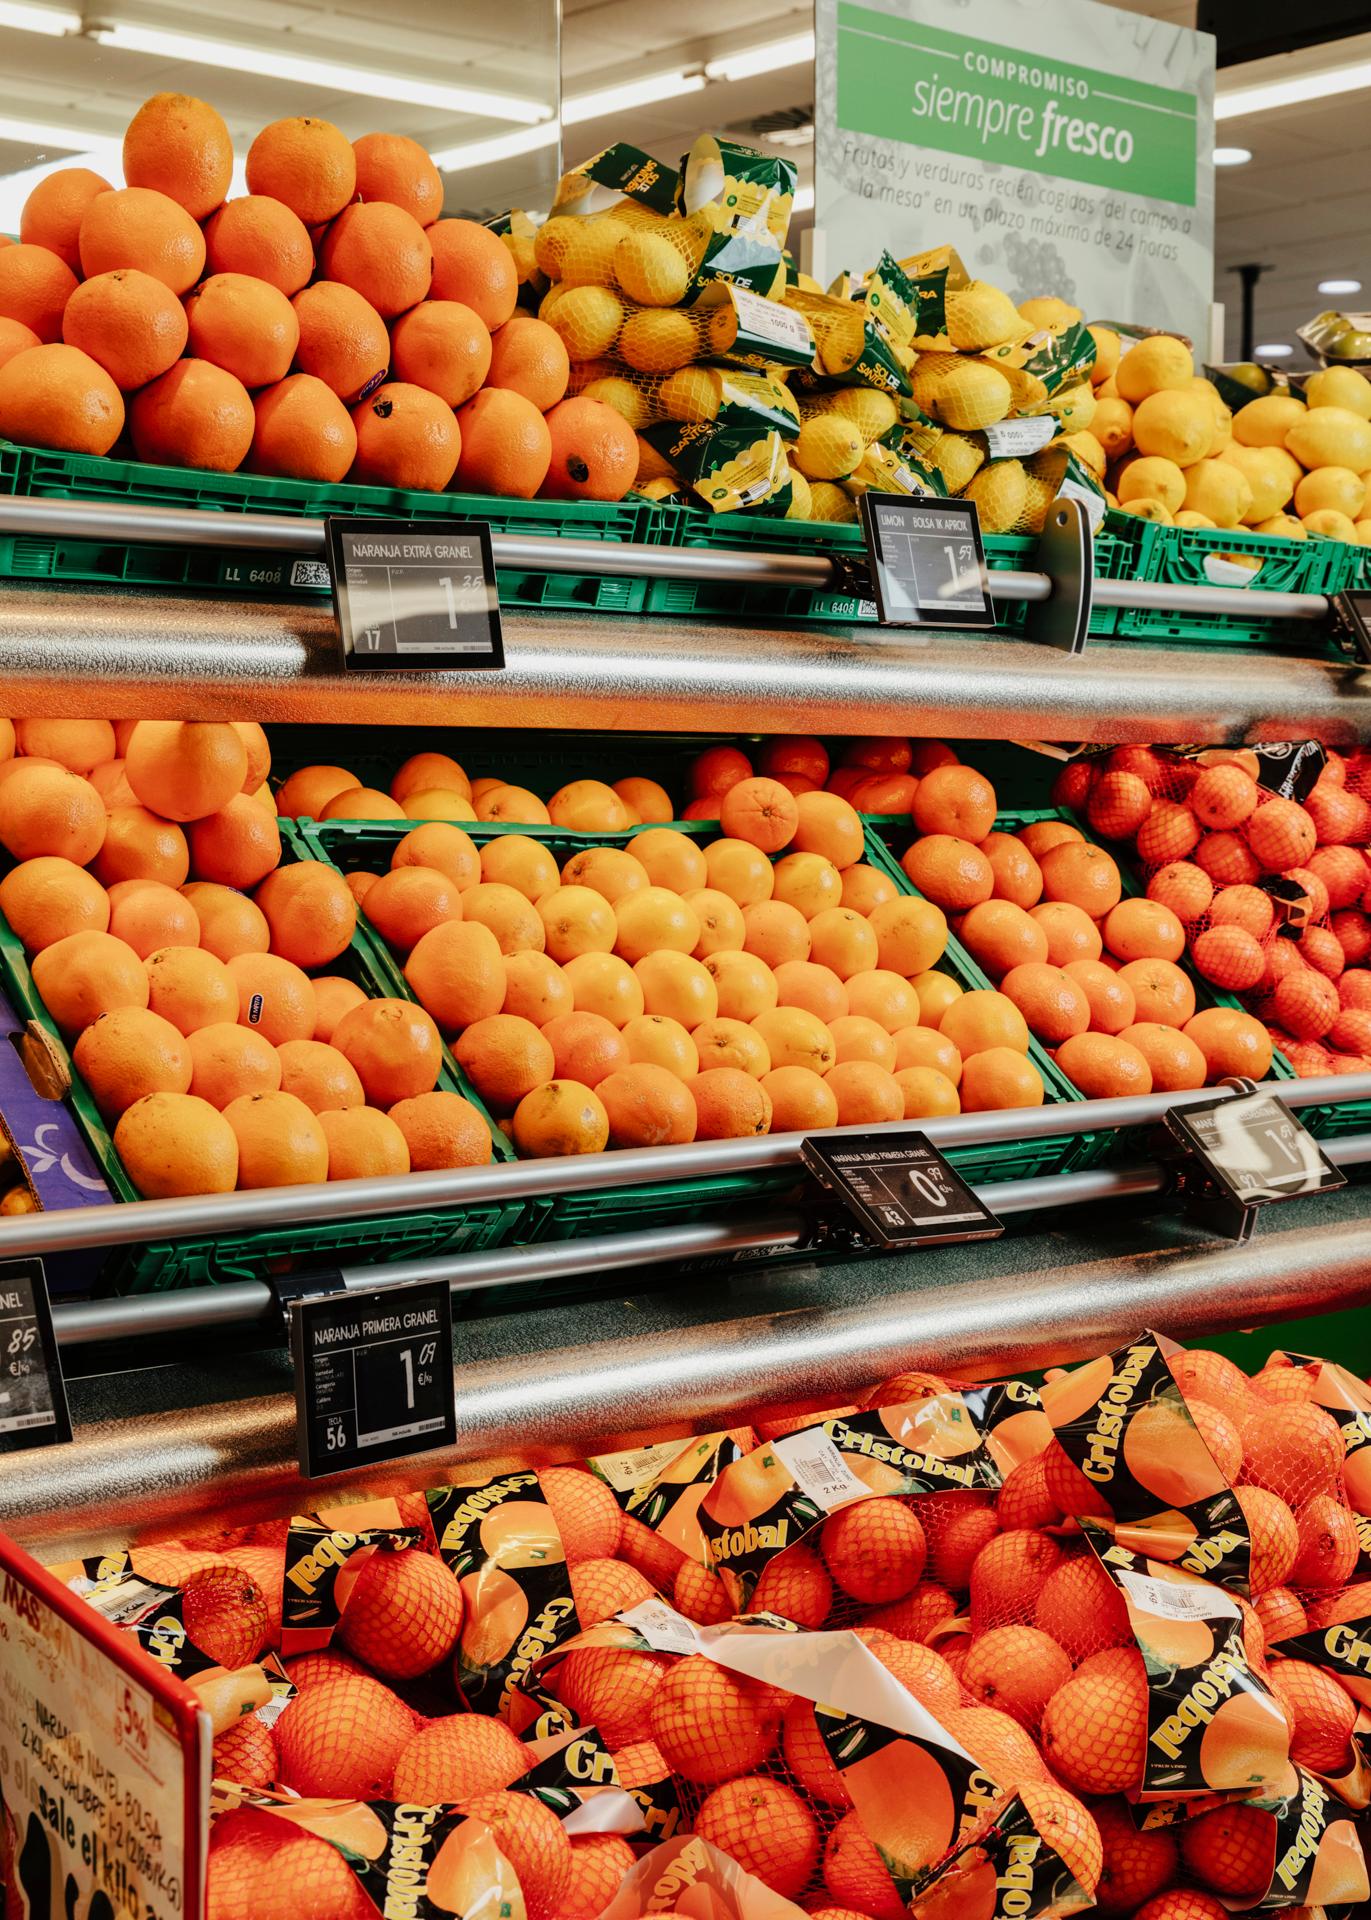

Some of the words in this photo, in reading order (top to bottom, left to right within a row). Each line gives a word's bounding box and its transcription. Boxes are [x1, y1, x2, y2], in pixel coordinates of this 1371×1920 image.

[963, 50, 1089, 100] COMPROMISO
[911, 73, 1035, 145] siempre
[1035, 100, 1134, 164] fresco
[842, 141, 894, 171] Frutas
[899, 158, 911, 180] y
[915, 160, 984, 191] verduras
[989, 175, 1033, 202] recién
[1038, 186, 1095, 215] cogidos
[1130, 206, 1178, 234] campo
[1182, 218, 1192, 234] a
[858, 177, 873, 199] la
[934, 197, 951, 214] en
[983, 203, 1025, 230] plazo
[1031, 214, 1090, 243] máximo
[1094, 228, 1111, 248] de
[1115, 230, 1134, 250] 24
[1138, 234, 1178, 261] horas
[880, 514, 905, 527] LIMON
[912, 516, 934, 529] BOLSA
[944, 518, 968, 531] APROX
[352, 544, 401, 557] NARANJA
[403, 544, 432, 558] EXTRA
[435, 545, 472, 559] GRANEL
[944, 545, 960, 591] 1
[958, 545, 972, 560] 59
[225, 567, 241, 581] LL
[249, 569, 281, 584] 6408
[439, 576, 458, 629] 1
[814, 601, 824, 612] LL
[831, 601, 855, 613] 6408
[364, 630, 381, 651] 17
[831, 1153, 861, 1163] NARANJA
[861, 1152, 879, 1162] ZUMO
[879, 1150, 906, 1160] PRIMERA
[905, 1149, 931, 1158] GRANEL
[927, 1167, 943, 1182] 99
[909, 1169, 947, 1207] 0
[883, 1210, 906, 1226] 43
[0, 1292, 23, 1309] NEL
[7, 1326, 37, 1354] 85
[314, 1324, 360, 1346] NARANJA
[362, 1315, 401, 1337] PRIMERA
[403, 1309, 438, 1327] GRANEL
[400, 1348, 415, 1409] 1
[1081, 1345, 1158, 1483] Cristobal
[326, 1425, 347, 1451] 56
[822, 1419, 975, 1488] Cristobal
[823, 1486, 831, 1495] 2
[439, 1474, 539, 1551] Cristobal
[21, 1722, 30, 1748] 2
[126, 1790, 163, 1852] BOLSA
[38, 1784, 76, 1849] sale
[81, 1829, 98, 1877] el
[102, 1841, 140, 1920] kilo
[385, 1803, 443, 1920] Cristoba
